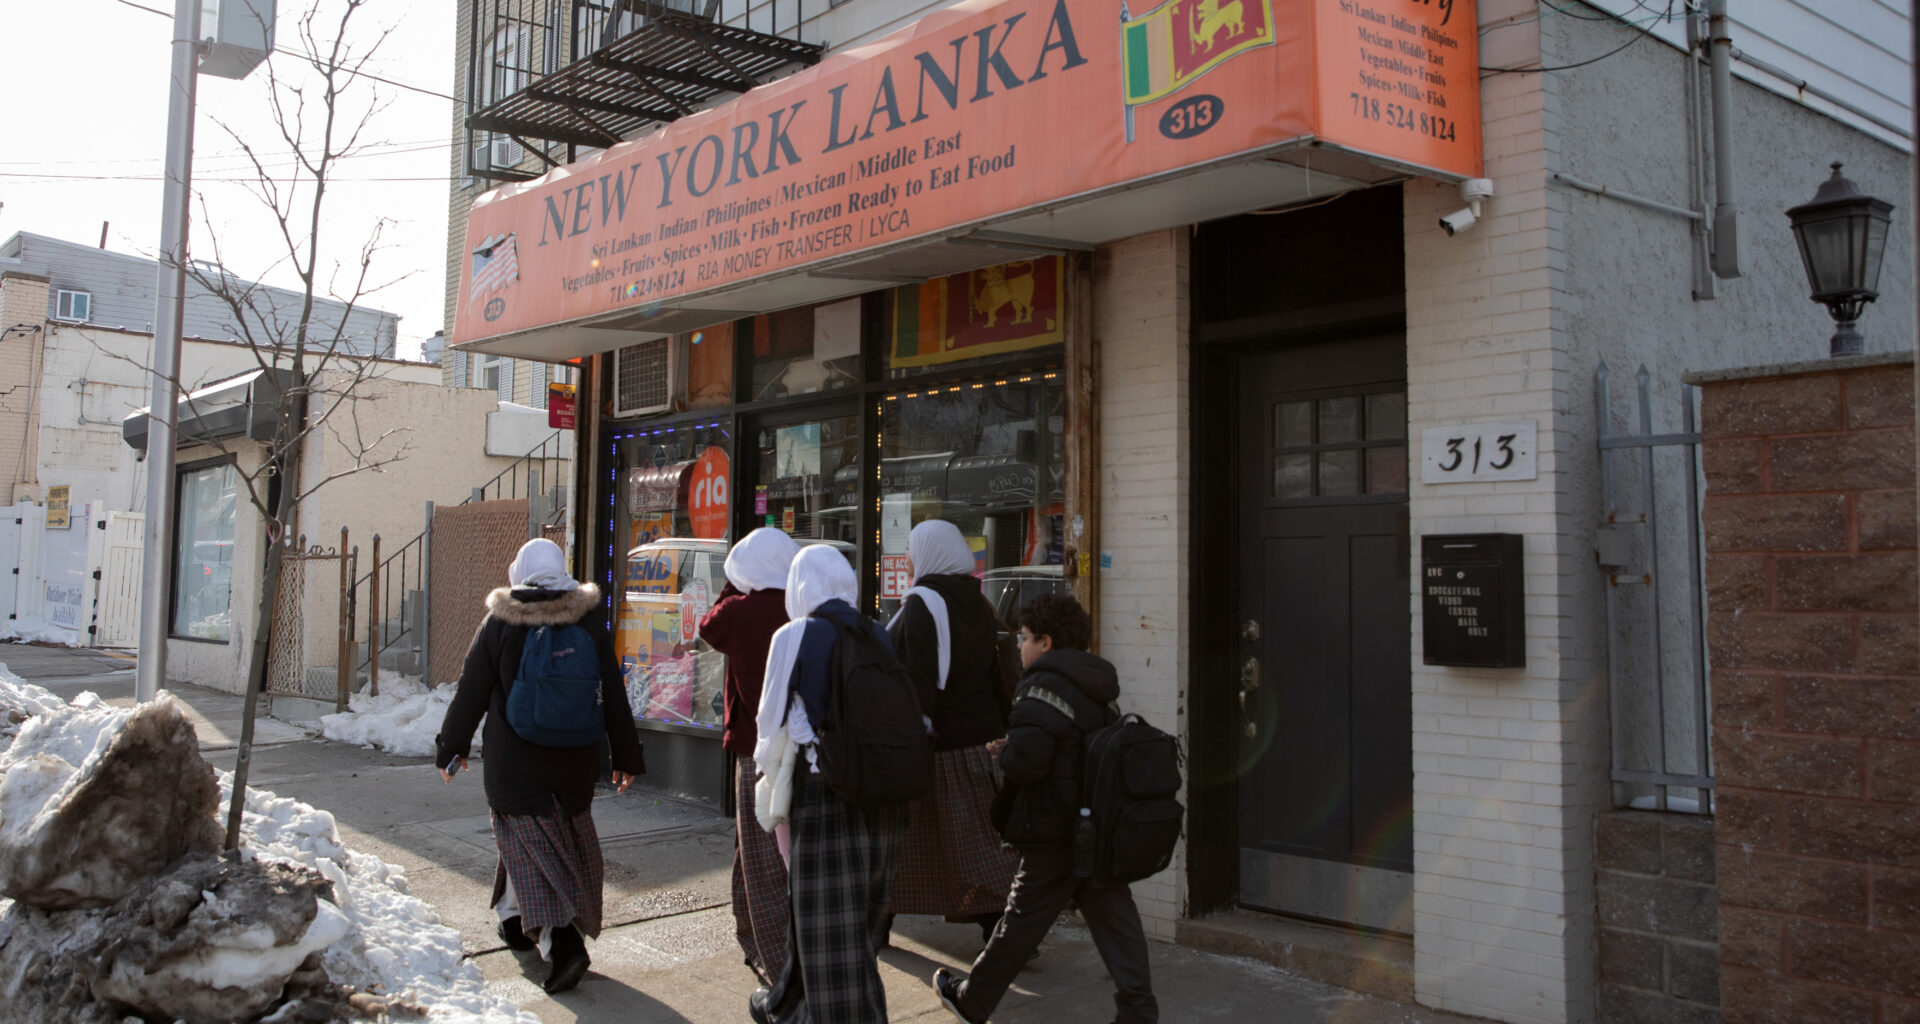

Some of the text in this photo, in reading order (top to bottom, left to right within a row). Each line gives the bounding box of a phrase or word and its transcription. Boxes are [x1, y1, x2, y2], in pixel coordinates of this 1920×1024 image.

[1339, 0, 1353, 15] Sri
[1355, 3, 1386, 25] Lankan
[1391, 14, 1417, 35] Indian
[1421, 25, 1458, 48] Philipines
[1358, 26, 1444, 66] Mexican Middle East
[1169, 99, 1213, 135] 313
[1350, 92, 1456, 143] 718 524 8124
[1427, 90, 1446, 108] Fish
[538, 0, 1088, 247] NEW YORK LANKA
[592, 130, 963, 260] Sri Lankan Indian Philipines Mexican Middle East
[789, 201, 842, 231] Frozen
[847, 182, 900, 214] Ready
[905, 178, 923, 198] to
[929, 164, 961, 191] Eat
[966, 145, 1017, 180] Food
[697, 208, 911, 282] RIA MONEY TRANSFER LYCA
[1438, 433, 1517, 474] 313
[695, 462, 727, 509] ria
[883, 558, 909, 571] WE ACC
[883, 571, 910, 596] EB
